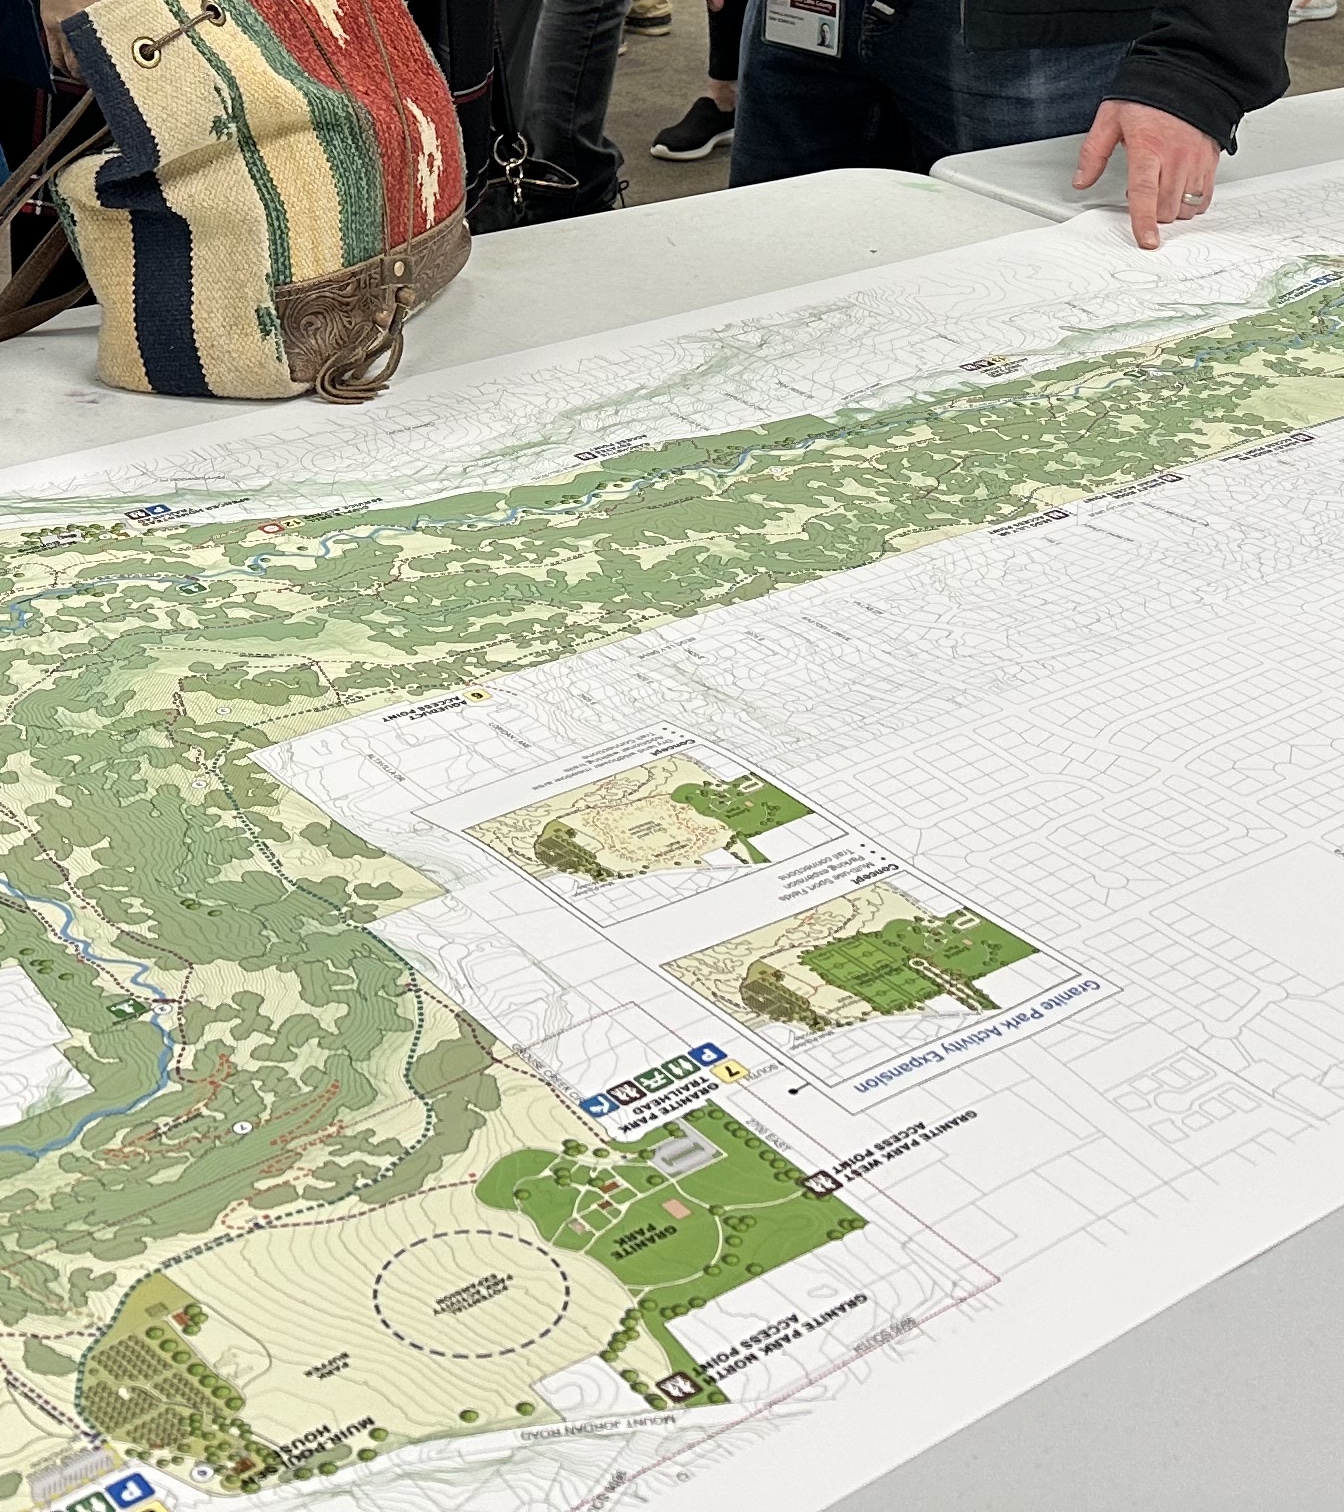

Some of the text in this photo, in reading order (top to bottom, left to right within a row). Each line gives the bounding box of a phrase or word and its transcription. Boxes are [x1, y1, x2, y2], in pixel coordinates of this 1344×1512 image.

[382, 696, 461, 723] ACCESS POINT
[409, 700, 467, 720] AQUEDUCT
[471, 692, 484, 700] 6
[651, 738, 698, 756] Concept
[832, 849, 855, 859] Trail
[783, 855, 866, 889] Parking expansion
[849, 863, 900, 886] Concept
[854, 979, 1101, 1096] Granite Park Activity Expansion
[725, 1065, 742, 1078] 7
[619, 1082, 720, 1135] GRANITE PARK
[631, 1076, 711, 1117] TRAILHEAD
[832, 1120, 927, 1176] ACCESS POINT
[843, 1109, 979, 1184] GRANITE PARK WEST
[609, 1223, 677, 1261] GRANITE PARK
[692, 1313, 800, 1378] ACCESS POINT
[703, 1293, 868, 1387] GRANITE PARK NORTH
[520, 1415, 676, 1442] MOUNT JORDAN ROAD
